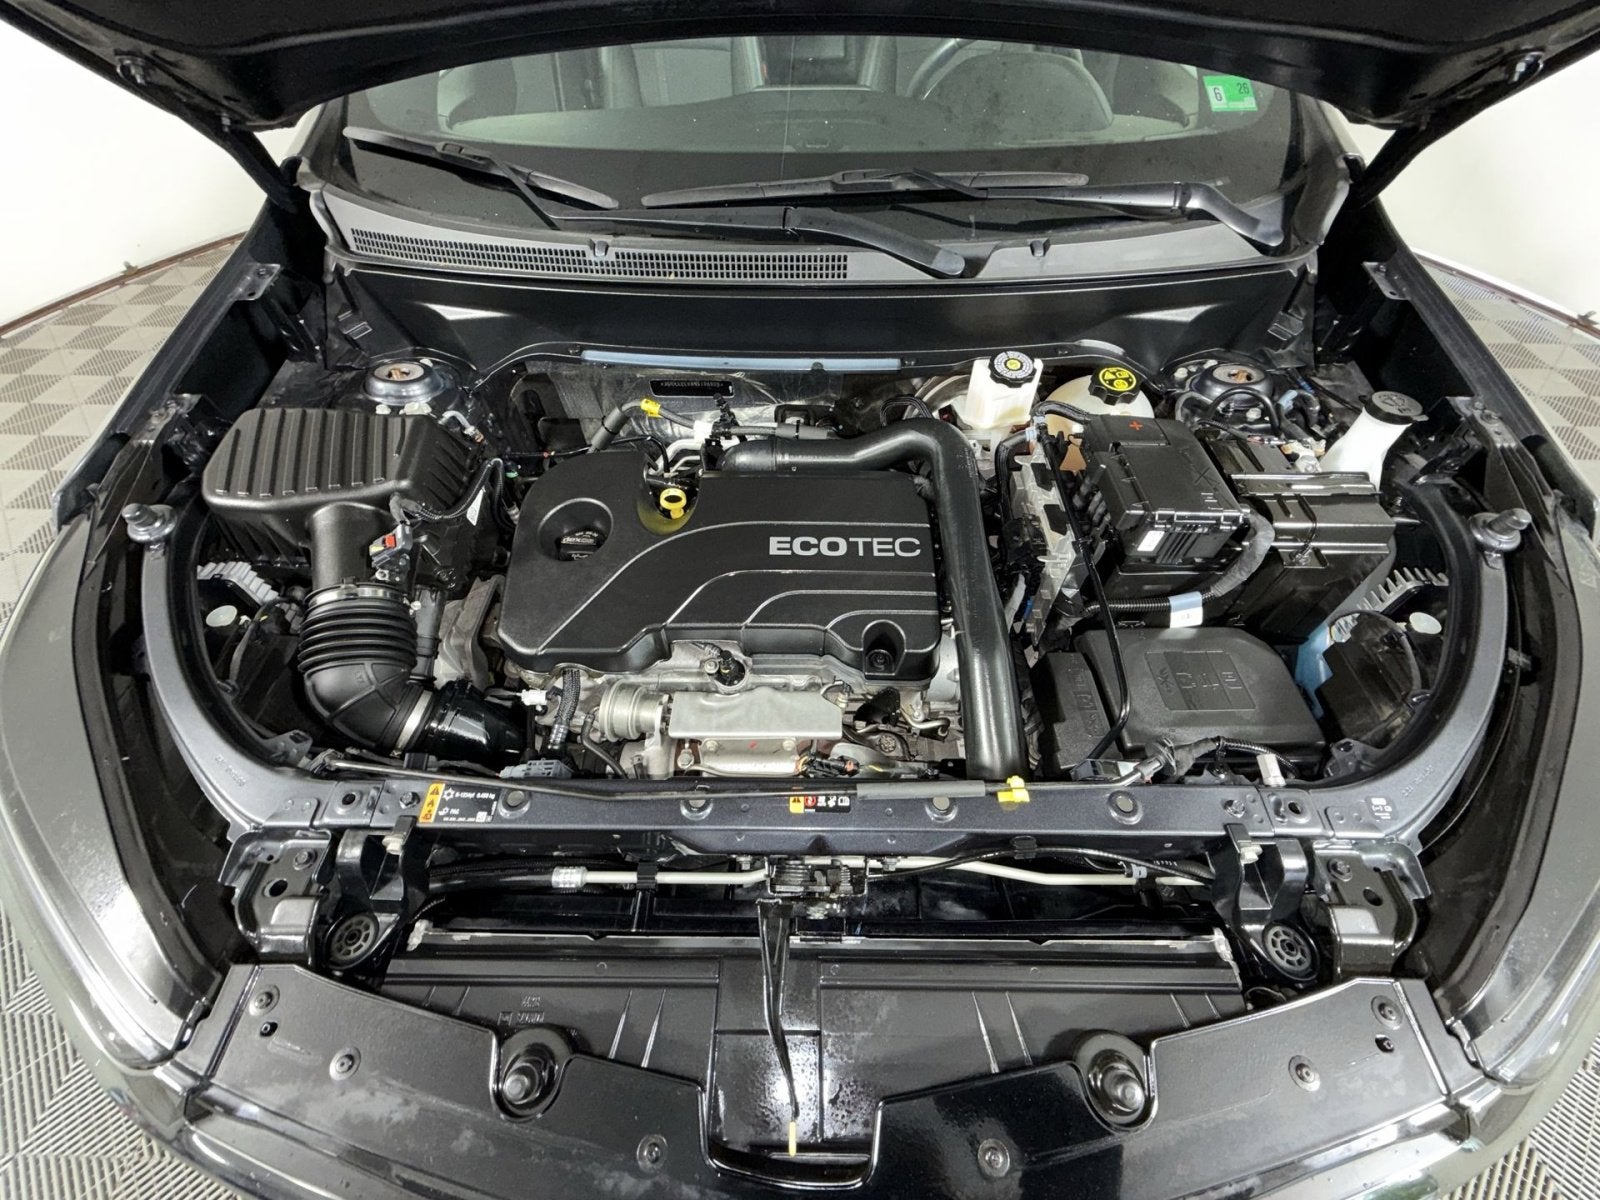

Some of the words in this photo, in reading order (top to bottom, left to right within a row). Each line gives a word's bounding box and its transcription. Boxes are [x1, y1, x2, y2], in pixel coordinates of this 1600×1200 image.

[1213, 86, 1223, 102] 6
[1236, 82, 1250, 95] 26
[768, 536, 922, 557] ECOTEC
